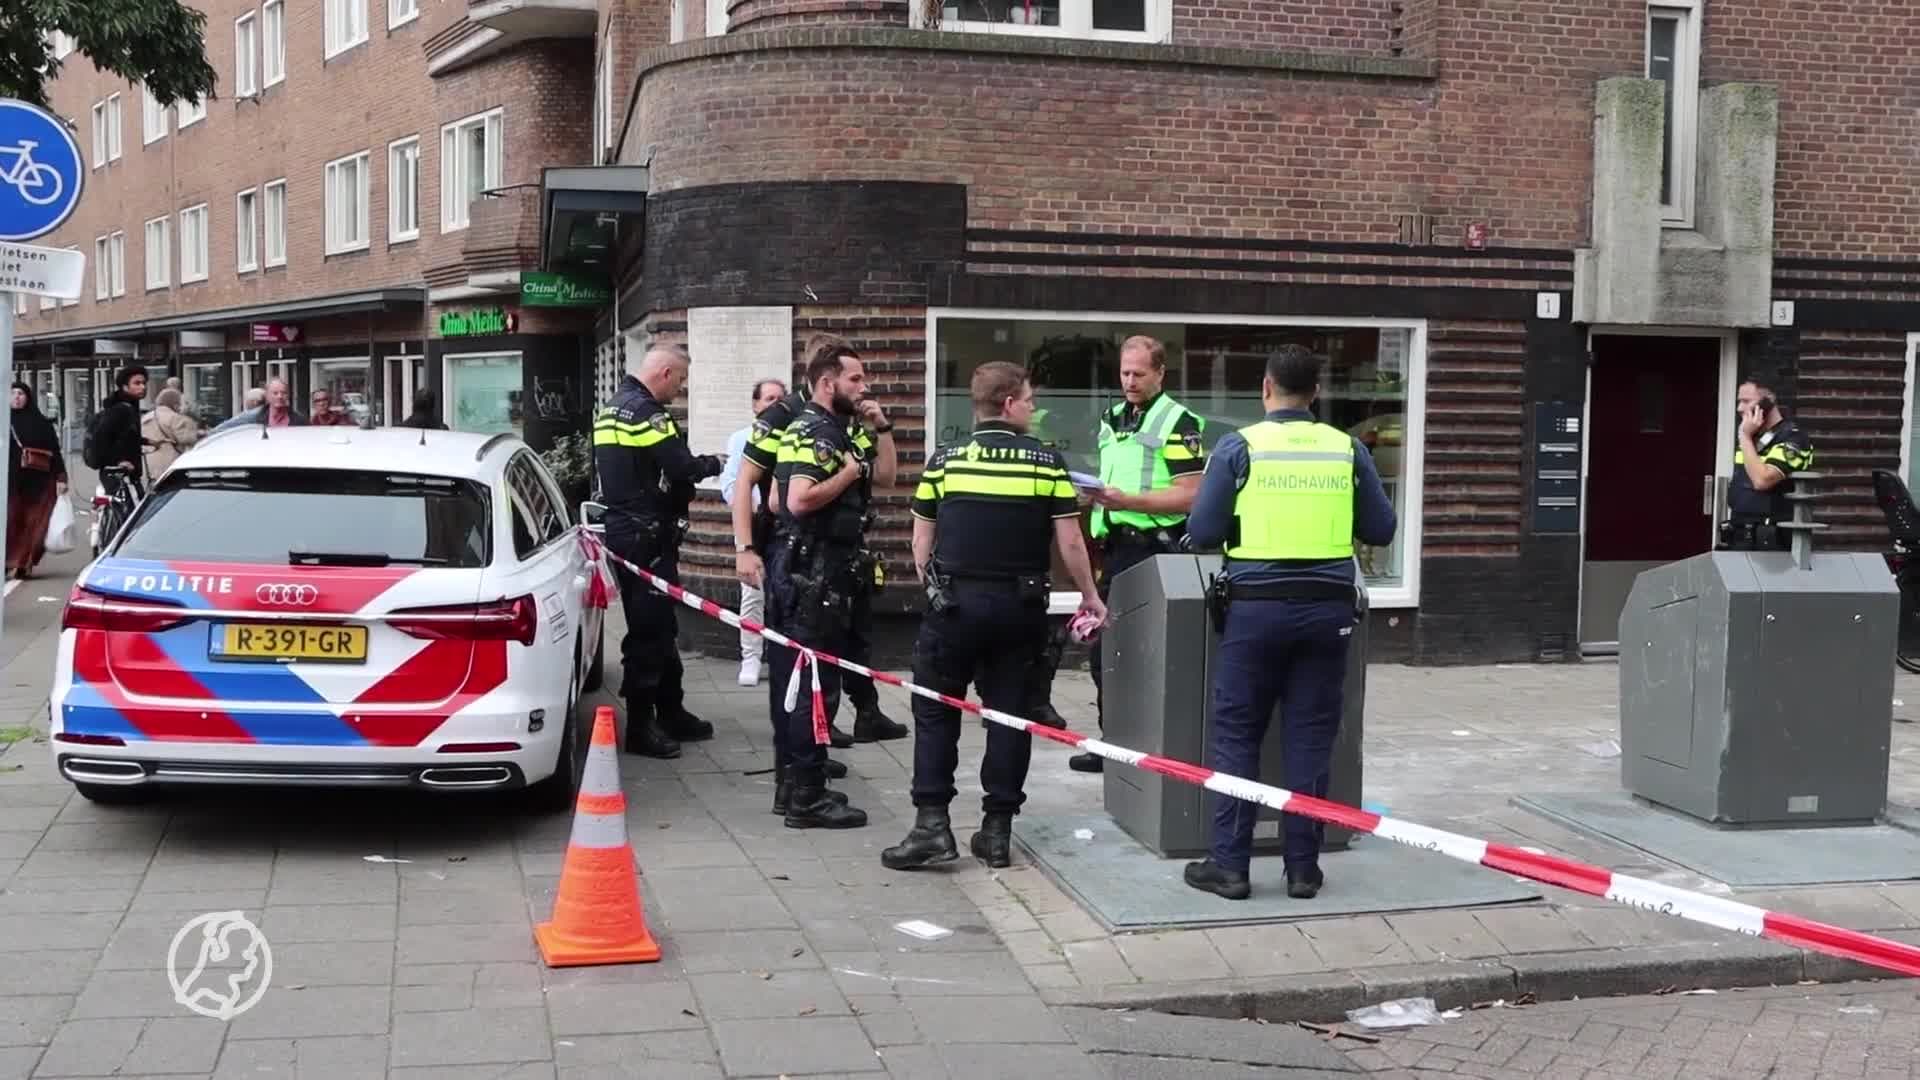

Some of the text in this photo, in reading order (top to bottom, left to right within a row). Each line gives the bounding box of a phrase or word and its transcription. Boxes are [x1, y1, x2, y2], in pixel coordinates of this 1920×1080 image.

[0, 247, 47, 261] ietsen
[1, 259, 22, 273] iet
[0, 276, 46, 290] estaan
[523, 281, 558, 295] China
[440, 312, 468, 336] China
[1256, 474, 1349, 490] HANDHAVING
[123, 575, 233, 593] POLITIE
[237, 627, 352, 654] R-391-GR
